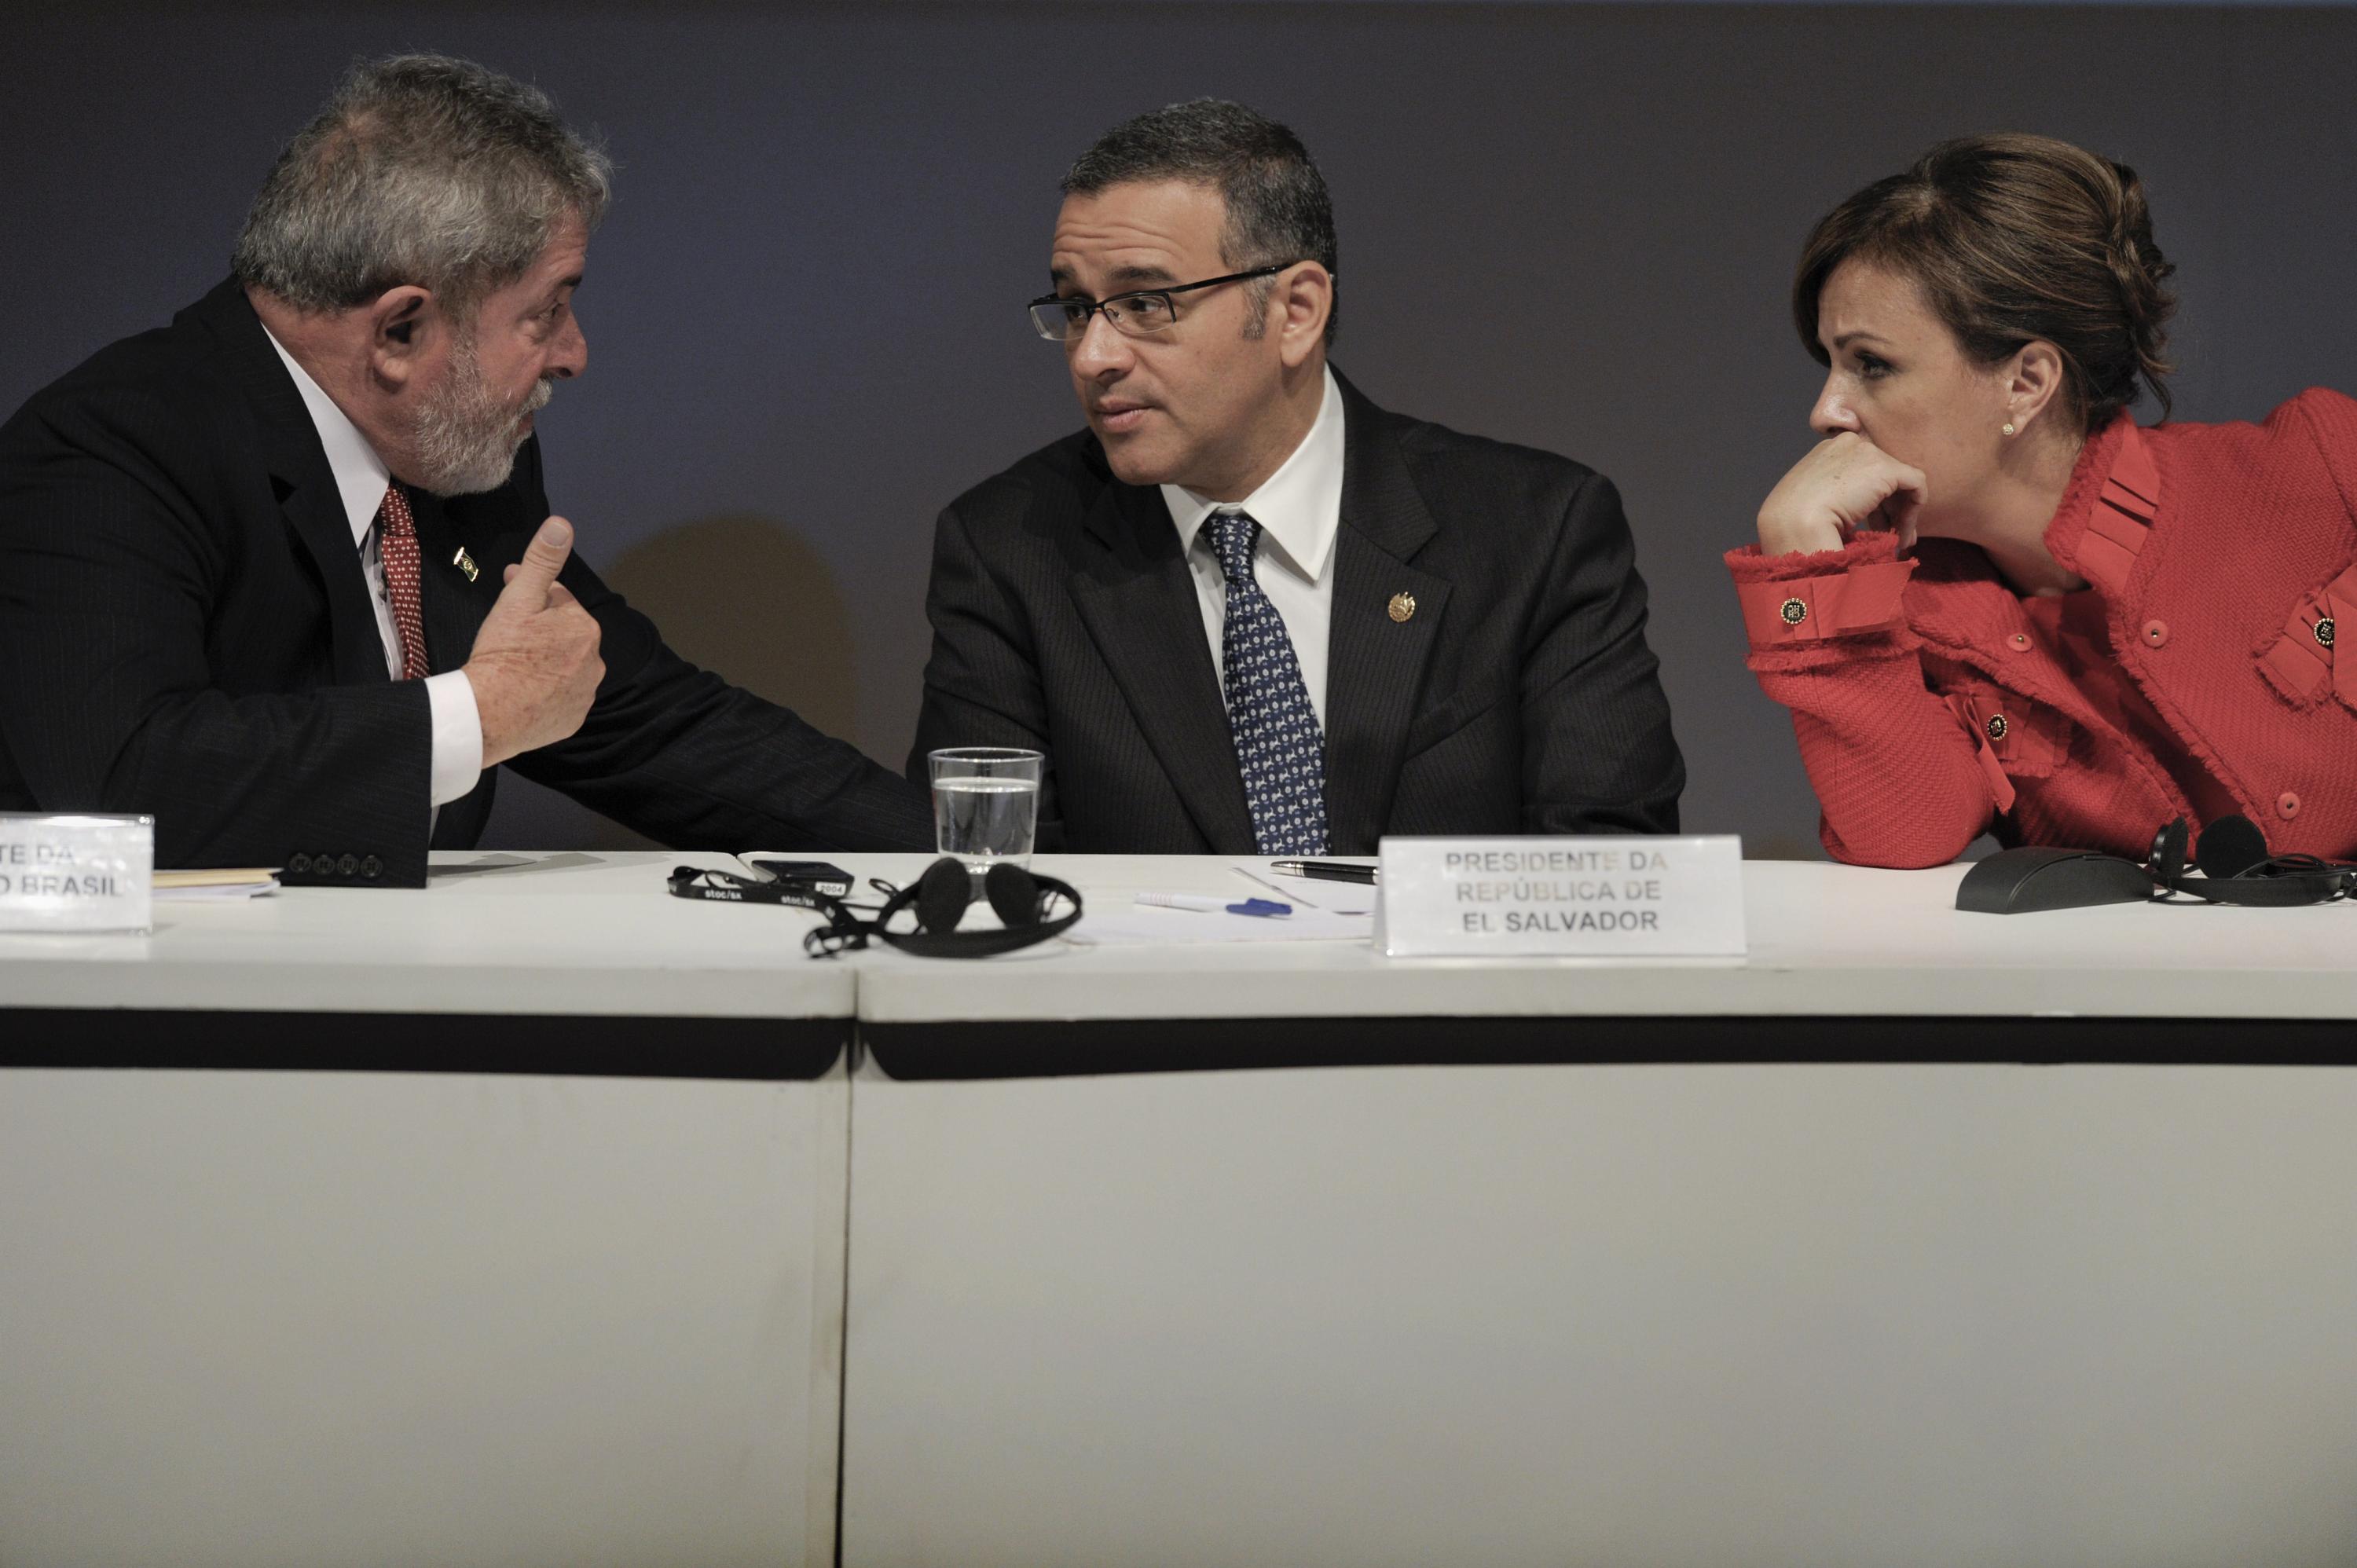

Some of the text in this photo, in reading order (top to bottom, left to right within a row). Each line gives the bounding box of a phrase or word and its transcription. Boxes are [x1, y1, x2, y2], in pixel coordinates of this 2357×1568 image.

[37, 844, 75, 865] DA
[1446, 850, 1669, 872] PRESIDENTE DA
[22, 876, 123, 896] BRASIL
[1456, 876, 1662, 902] REPÚBLICA DE
[1462, 910, 1659, 933] EL SALVADOR
